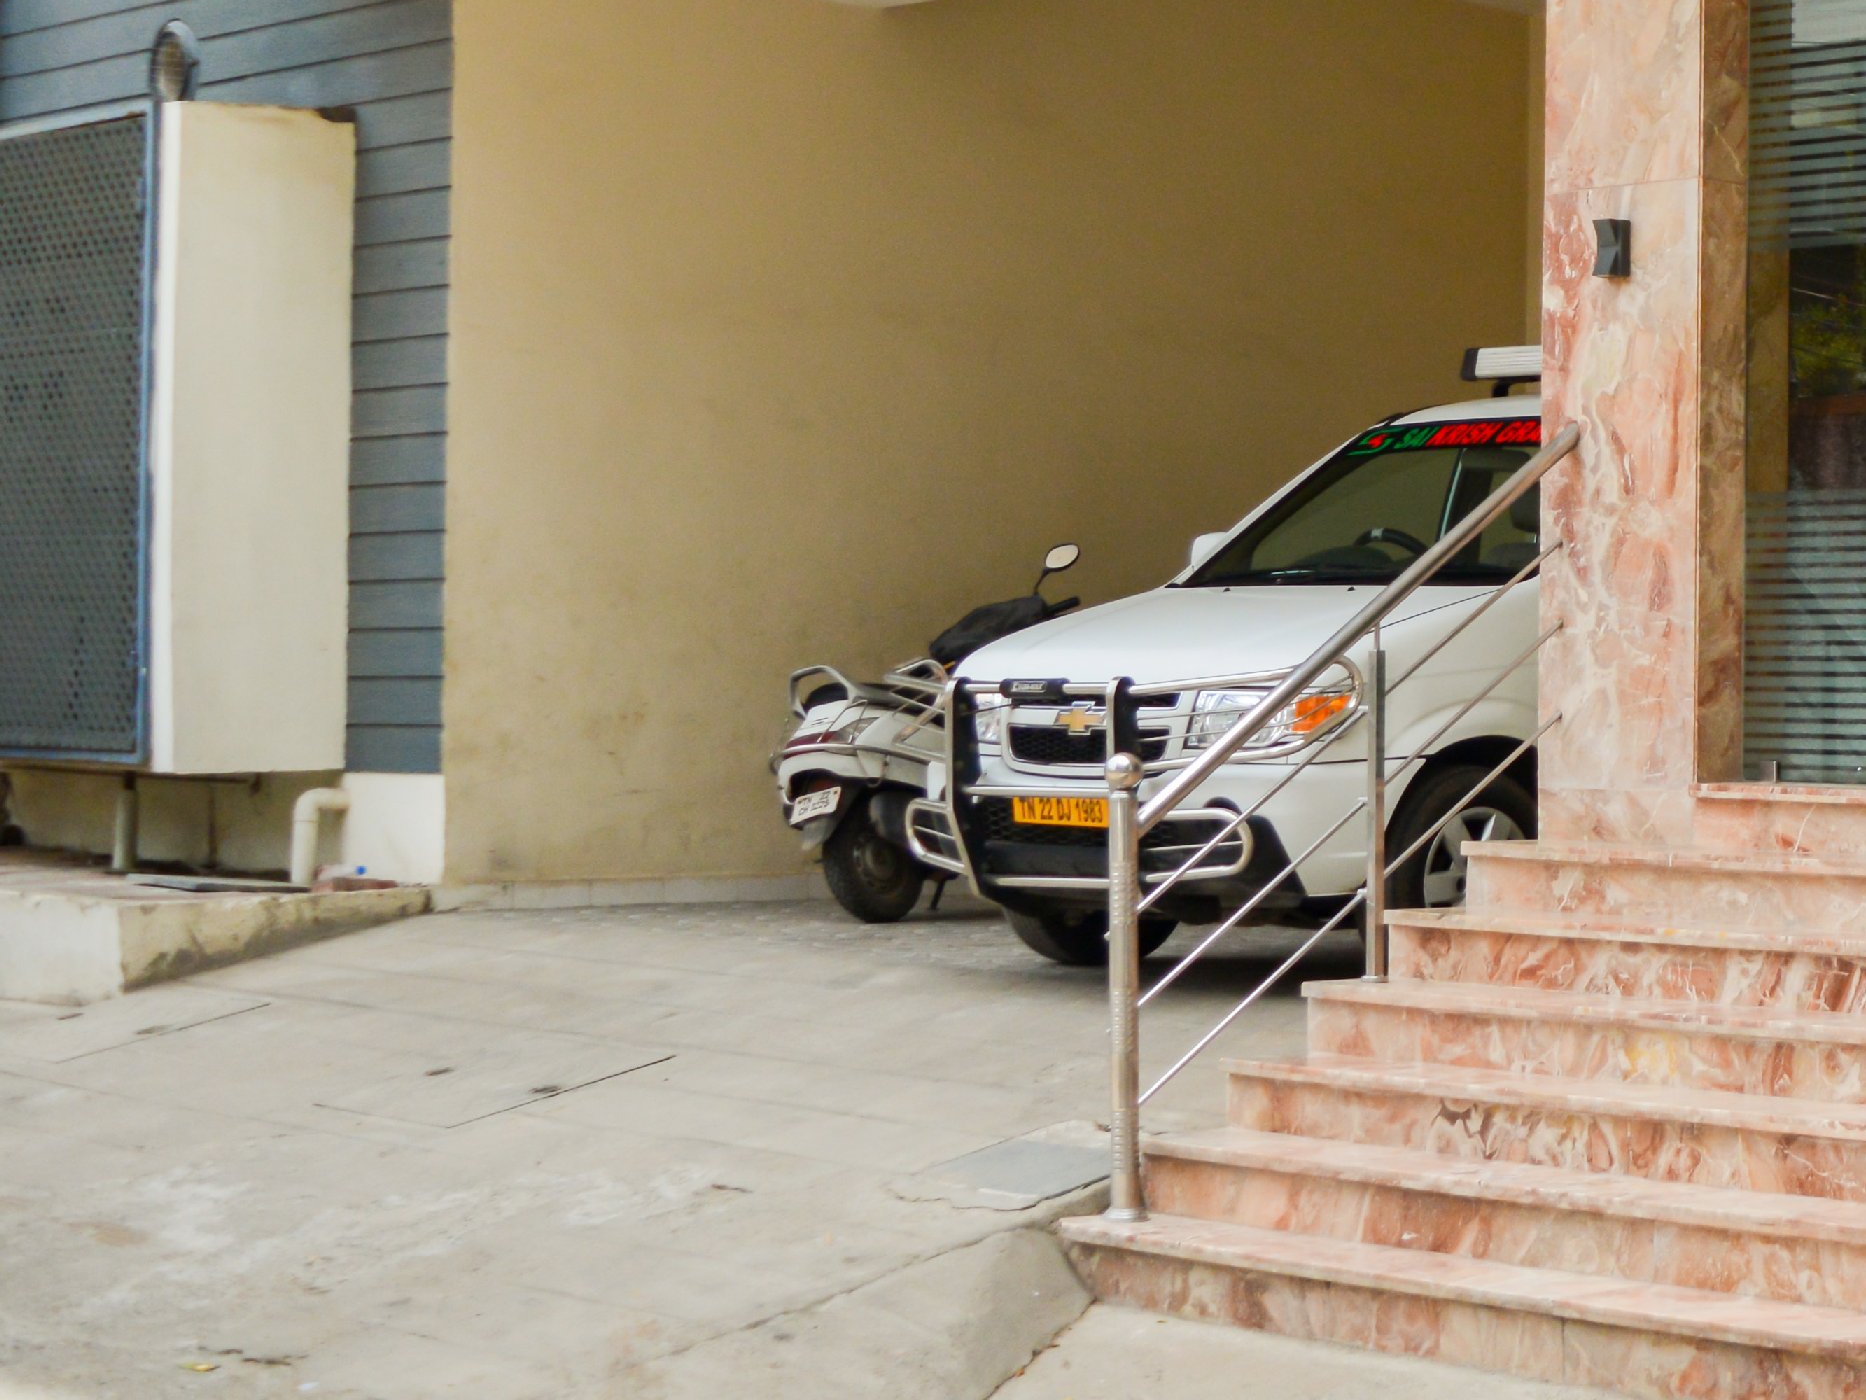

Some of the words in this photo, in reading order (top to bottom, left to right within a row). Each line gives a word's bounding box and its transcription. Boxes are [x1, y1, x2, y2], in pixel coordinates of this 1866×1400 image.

[1394, 424, 1440, 449] SAI
[1425, 421, 1503, 448] KRISH
[1018, 796, 1037, 820] TN
[1039, 796, 1054, 820] 22
[1075, 798, 1103, 823] 1983
